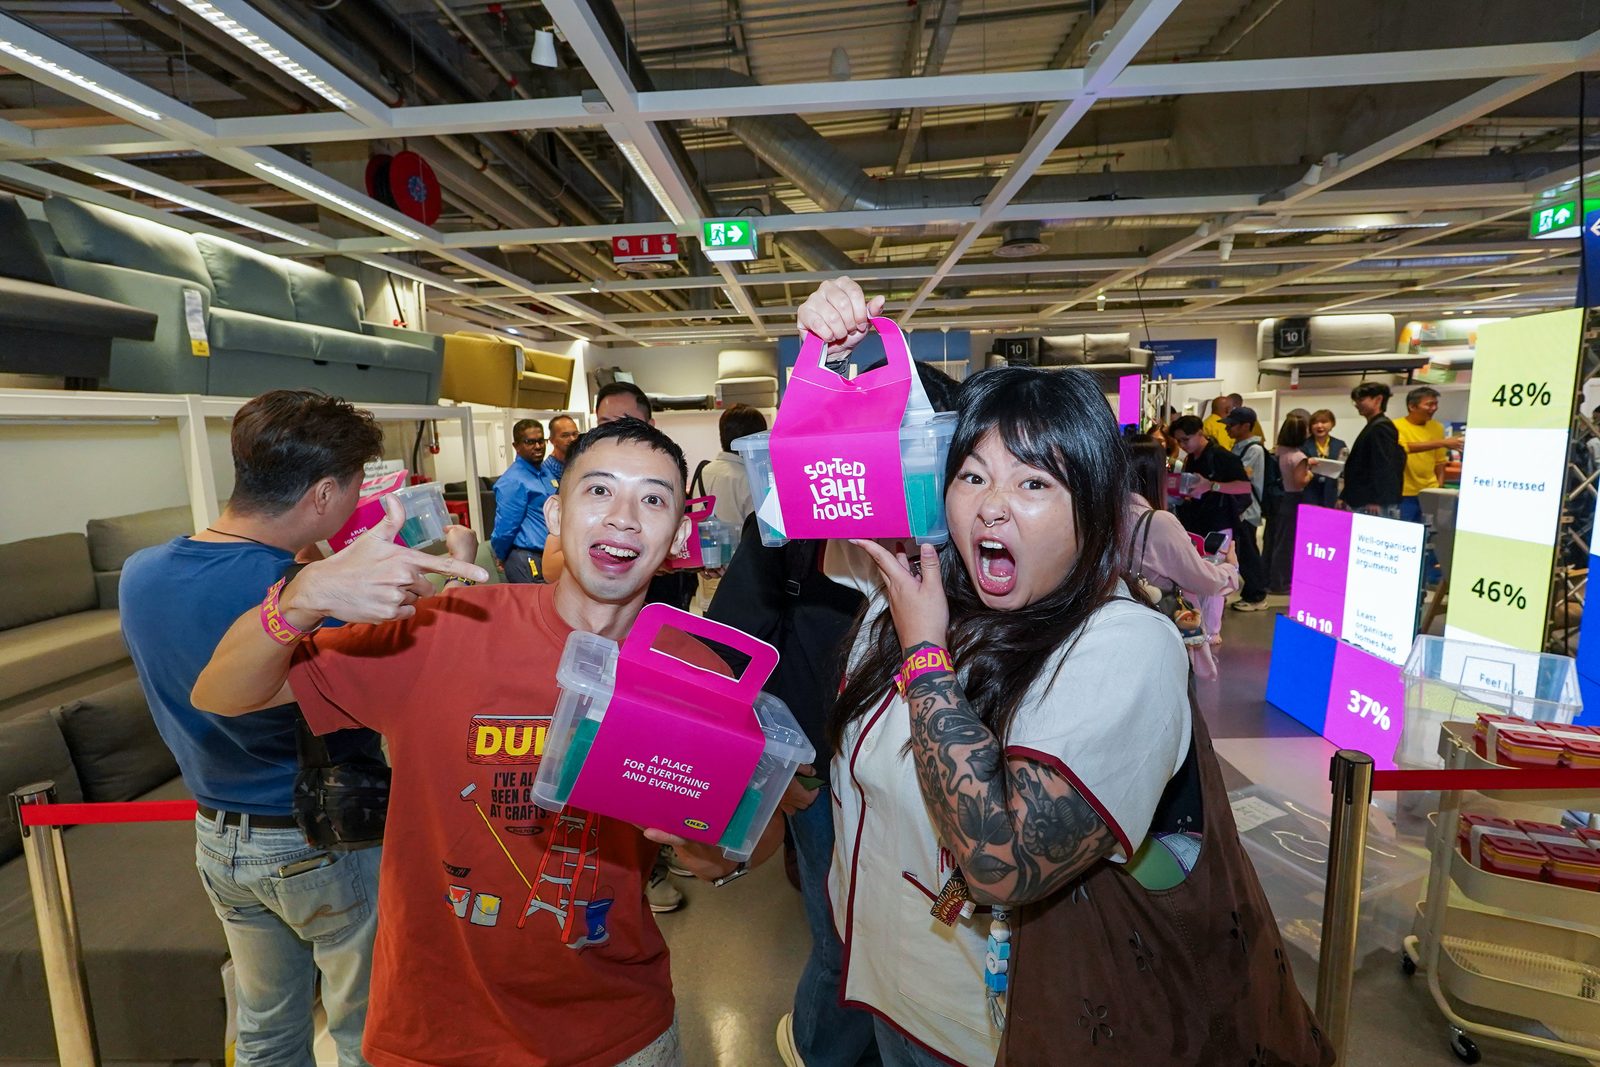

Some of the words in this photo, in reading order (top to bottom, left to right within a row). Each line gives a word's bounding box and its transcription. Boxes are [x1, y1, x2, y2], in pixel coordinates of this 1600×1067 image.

[1284, 331, 1299, 342] 10
[1009, 344, 1023, 354] 10
[1491, 381, 1551, 407] 48%
[1473, 476, 1494, 487] Feel
[1497, 479, 1546, 492] stressed
[1306, 542, 1313, 556] 1
[1314, 543, 1326, 559] in
[1327, 547, 1336, 561] 7
[1357, 533, 1417, 554] Well-organised
[1356, 546, 1381, 558] homes
[1384, 551, 1399, 562] had
[1355, 558, 1398, 575] arguments
[1471, 577, 1527, 610] 46%
[1296, 610, 1305, 622] 6
[1305, 611, 1318, 630] in
[1318, 618, 1333, 634] 10
[1356, 609, 1377, 622] Least
[1355, 622, 1394, 640] organised
[1354, 632, 1379, 648] homes
[1381, 642, 1397, 654] had
[1479, 672, 1501, 689] Feel
[1346, 689, 1391, 731] 37%
[650, 755, 659, 764] A
[660, 757, 694, 774] PLACE
[494, 772, 516, 788] I'VE
[623, 758, 646, 772] FOR
[646, 765, 711, 790] EVERYTHING
[622, 770, 647, 783] AND
[648, 777, 702, 800] EVERYONE
[490, 788, 519, 804] BEEN
[490, 805, 502, 818] AT
[686, 819, 708, 831] IKEA
